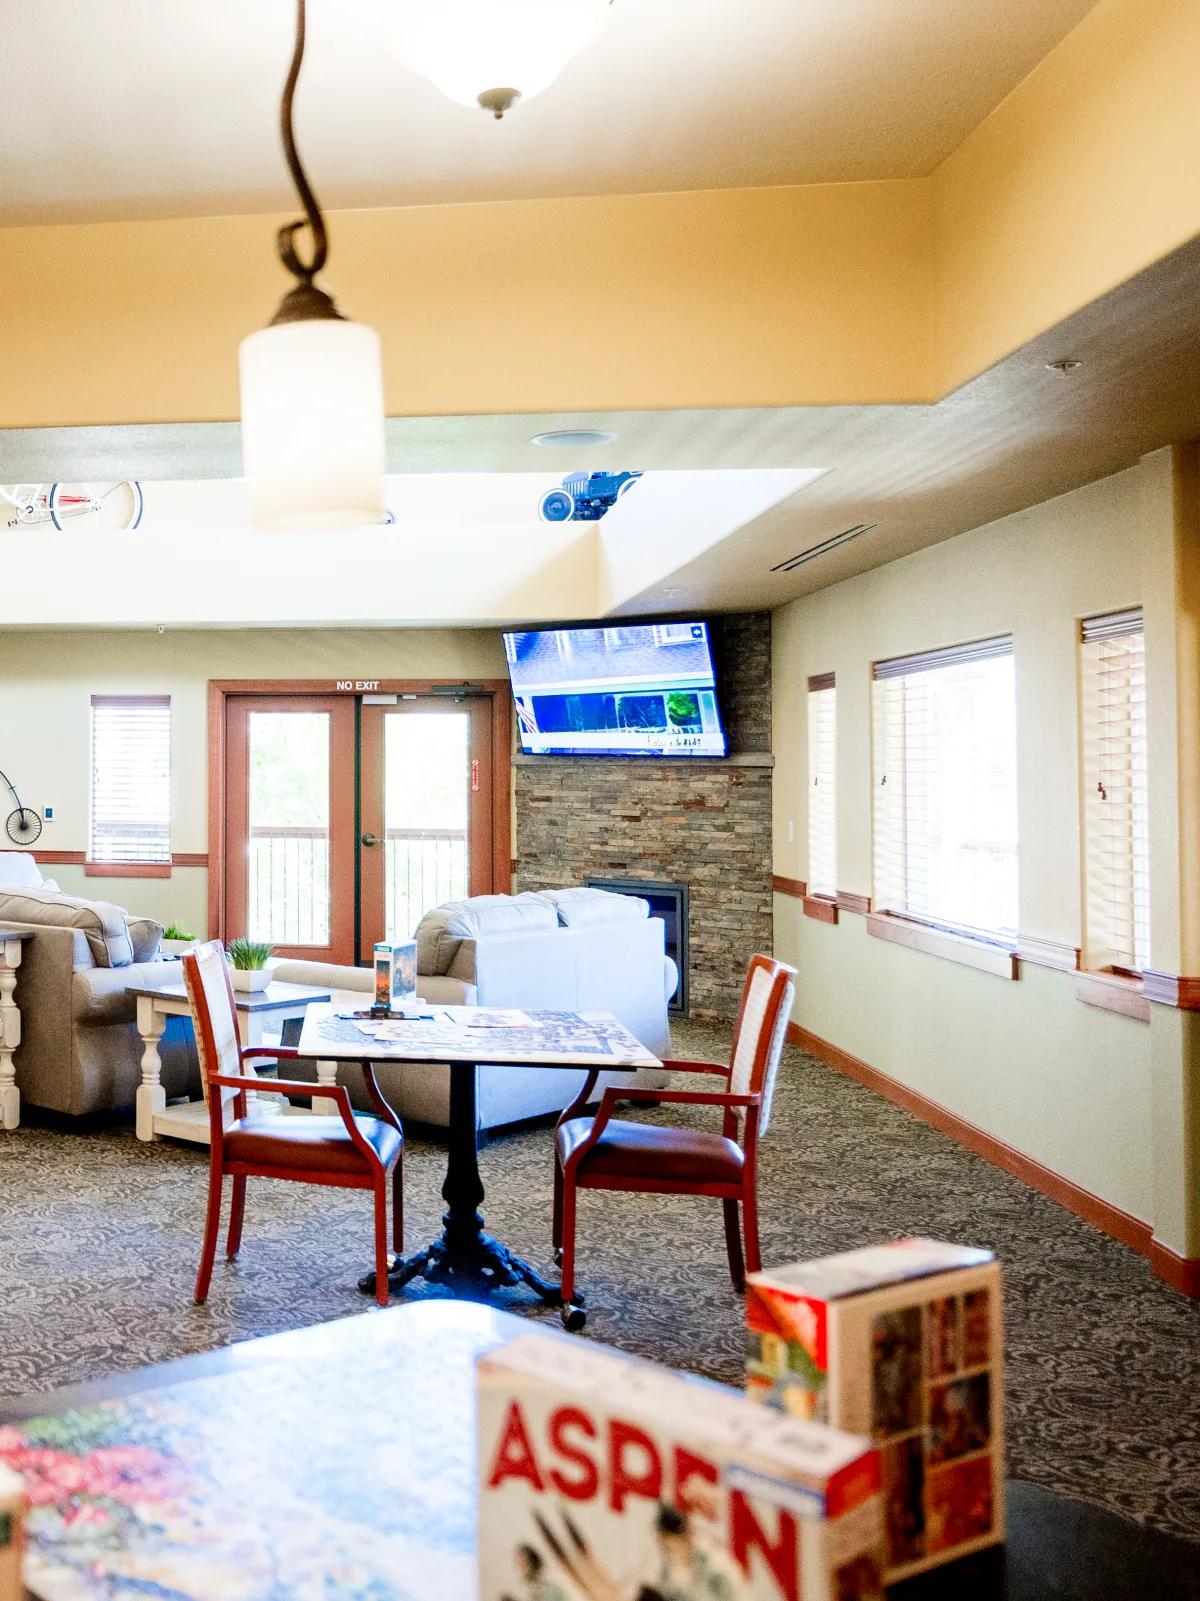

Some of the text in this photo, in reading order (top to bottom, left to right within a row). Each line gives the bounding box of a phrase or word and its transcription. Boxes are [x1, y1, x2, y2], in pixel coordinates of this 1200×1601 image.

[336, 681, 380, 690] NO EXIT
[488, 1395, 800, 1601] ASPEN
